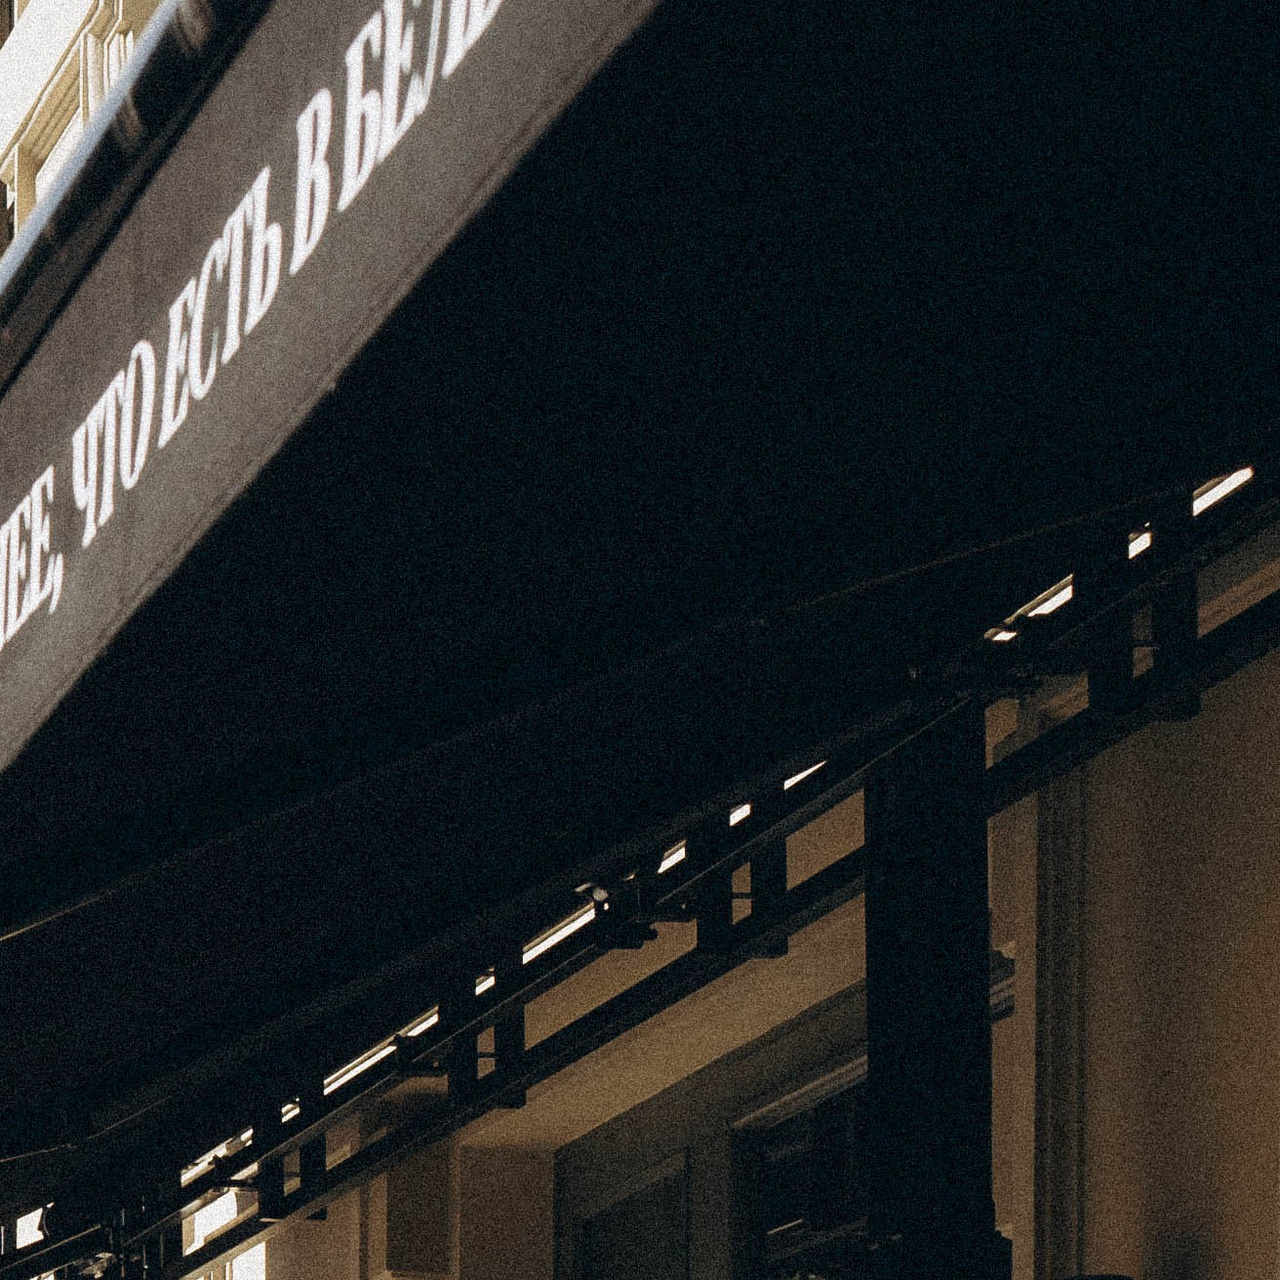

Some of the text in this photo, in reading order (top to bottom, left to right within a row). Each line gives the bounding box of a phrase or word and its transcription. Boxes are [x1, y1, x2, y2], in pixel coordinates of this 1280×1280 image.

[72, 340, 156, 549] ЧТО
[157, 165, 282, 449] ЕСТЬ
[288, 88, 332, 276] В
